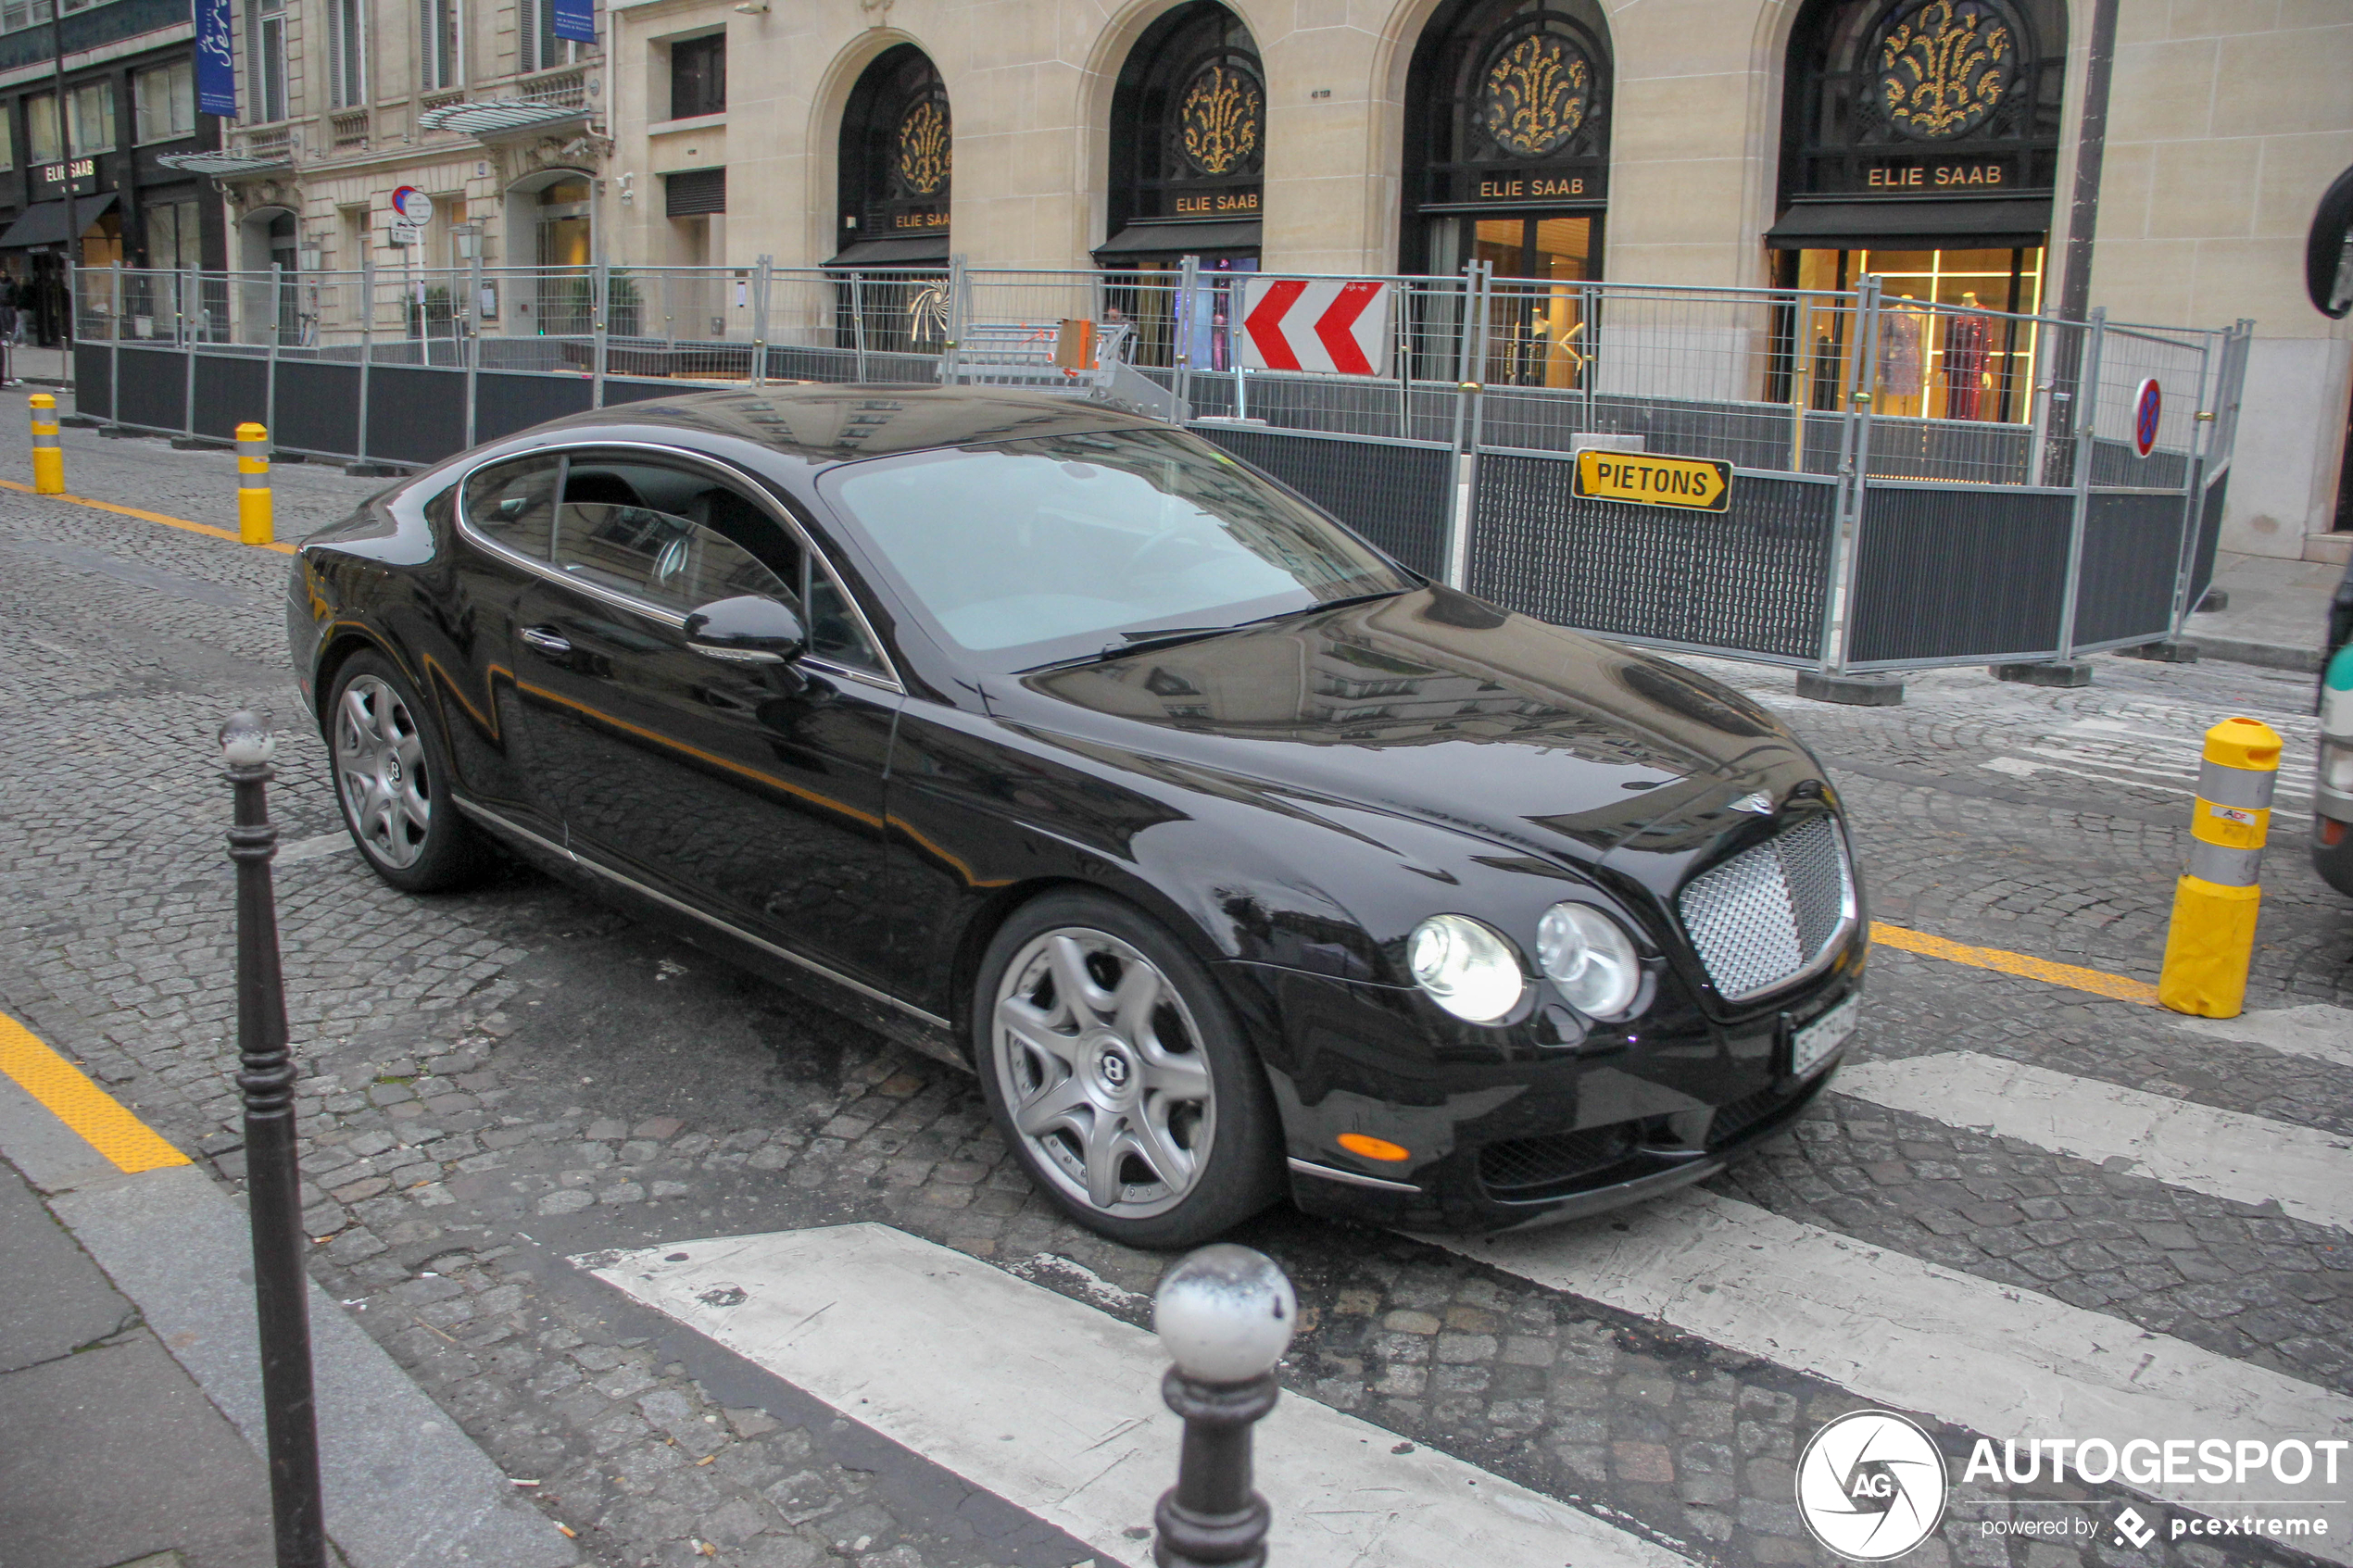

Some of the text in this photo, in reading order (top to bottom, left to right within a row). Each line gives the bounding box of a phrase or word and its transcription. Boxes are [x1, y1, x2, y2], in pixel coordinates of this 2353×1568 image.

[45, 159, 94, 182] ELIE SAAB
[1869, 166, 2002, 186] ELIE SAAB
[1480, 178, 1584, 196] ELIE SAAB
[1176, 194, 1258, 211] ELIE SAAB
[896, 213, 950, 228] ELIE SAA
[1598, 462, 1708, 496] PIETONS
